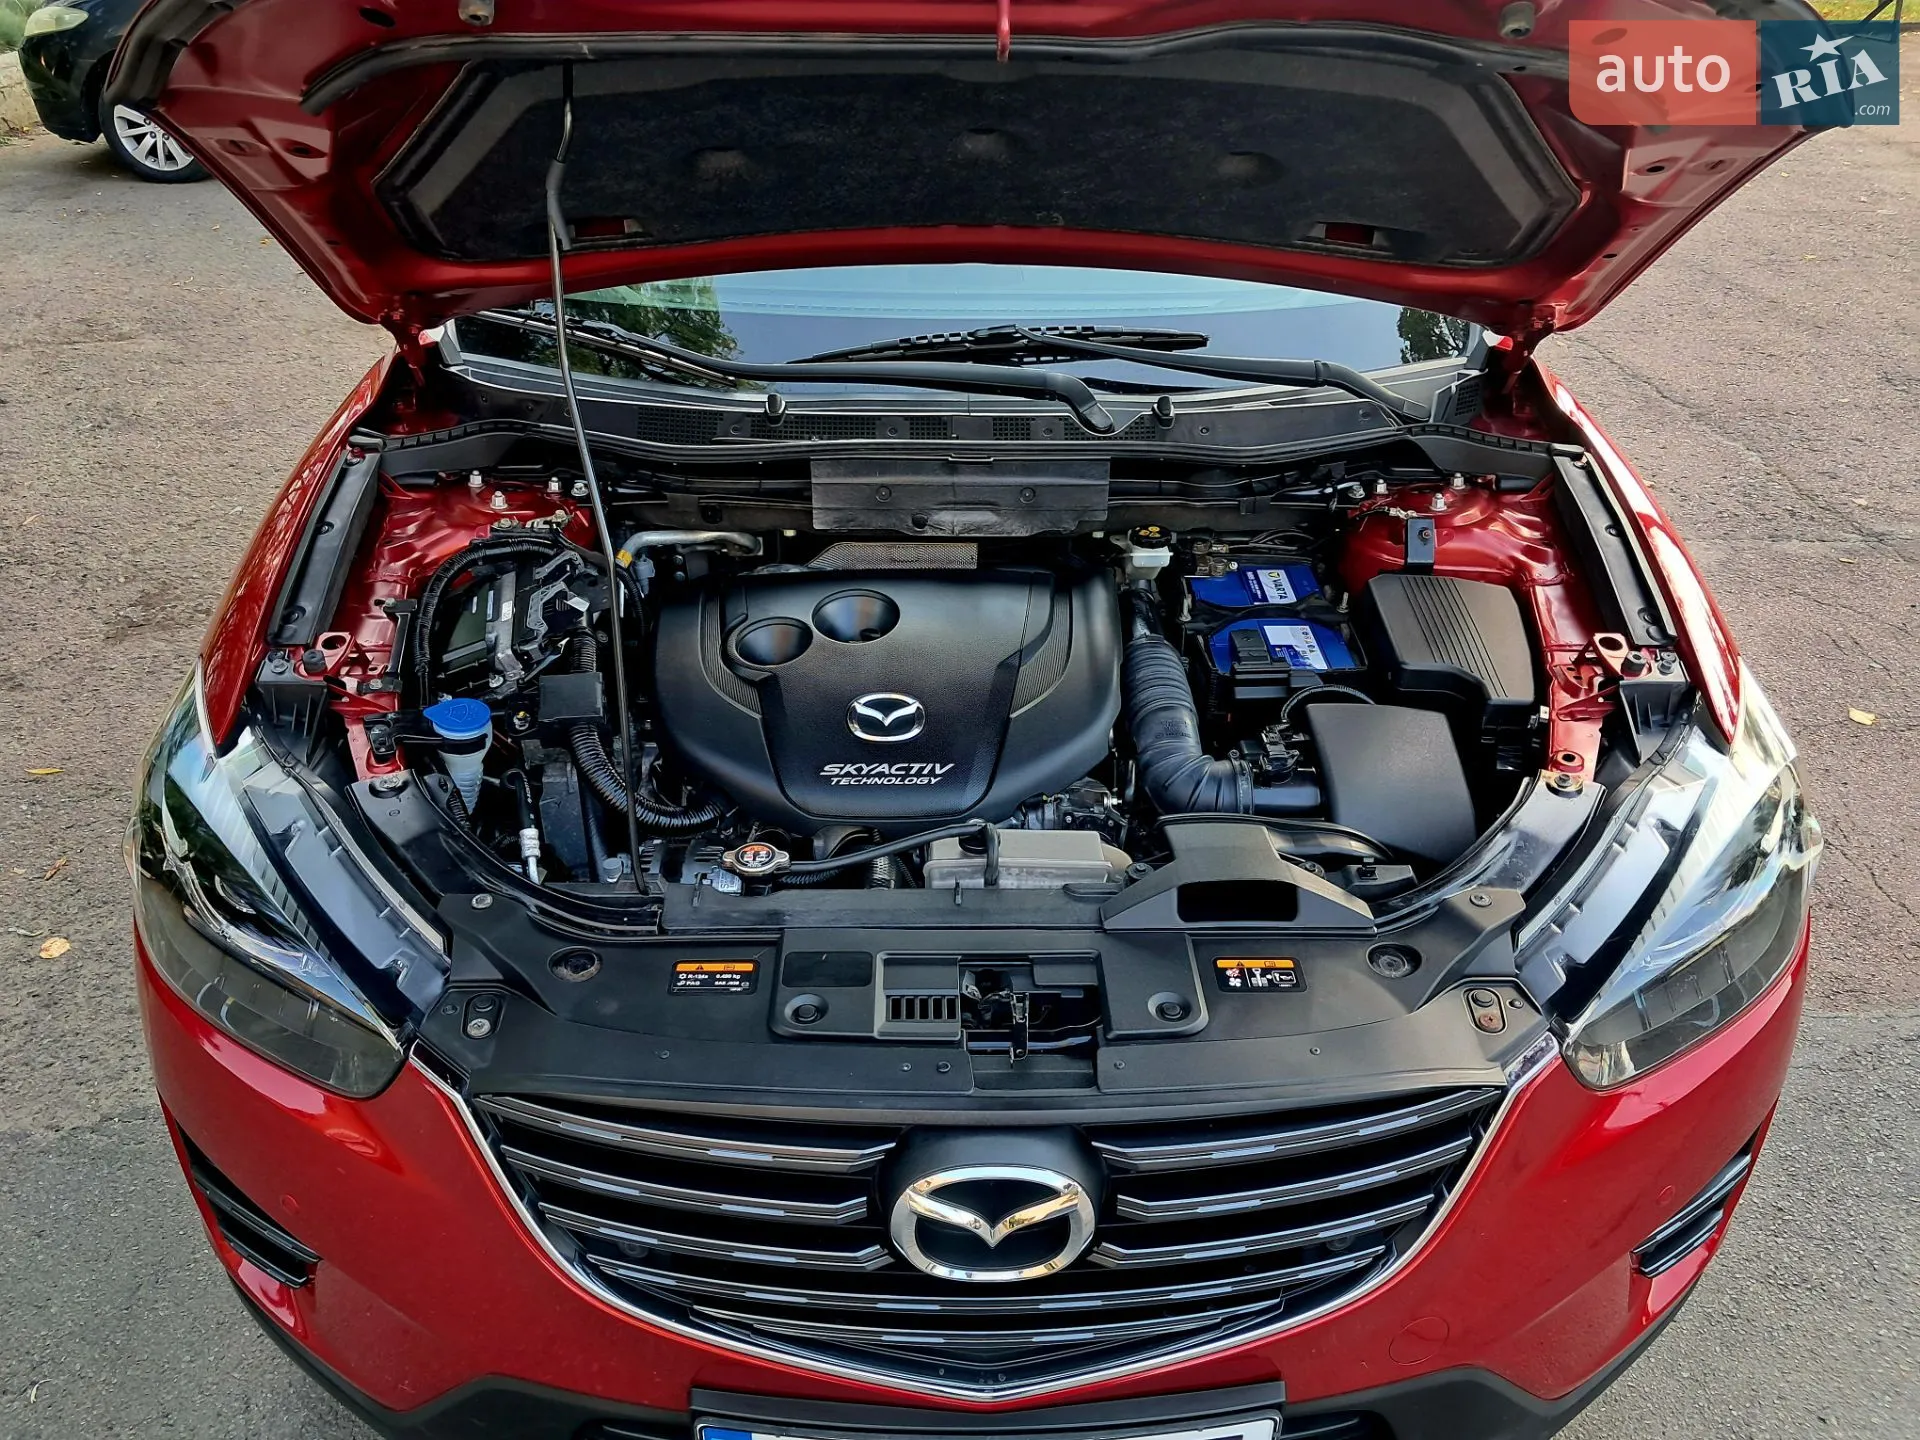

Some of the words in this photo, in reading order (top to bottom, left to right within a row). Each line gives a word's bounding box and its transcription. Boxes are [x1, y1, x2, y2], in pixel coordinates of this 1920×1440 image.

[1272, 578, 1289, 600] VARTA
[819, 763, 955, 776] SKYACTIV
[830, 777, 942, 785] TECHNOLOGY
